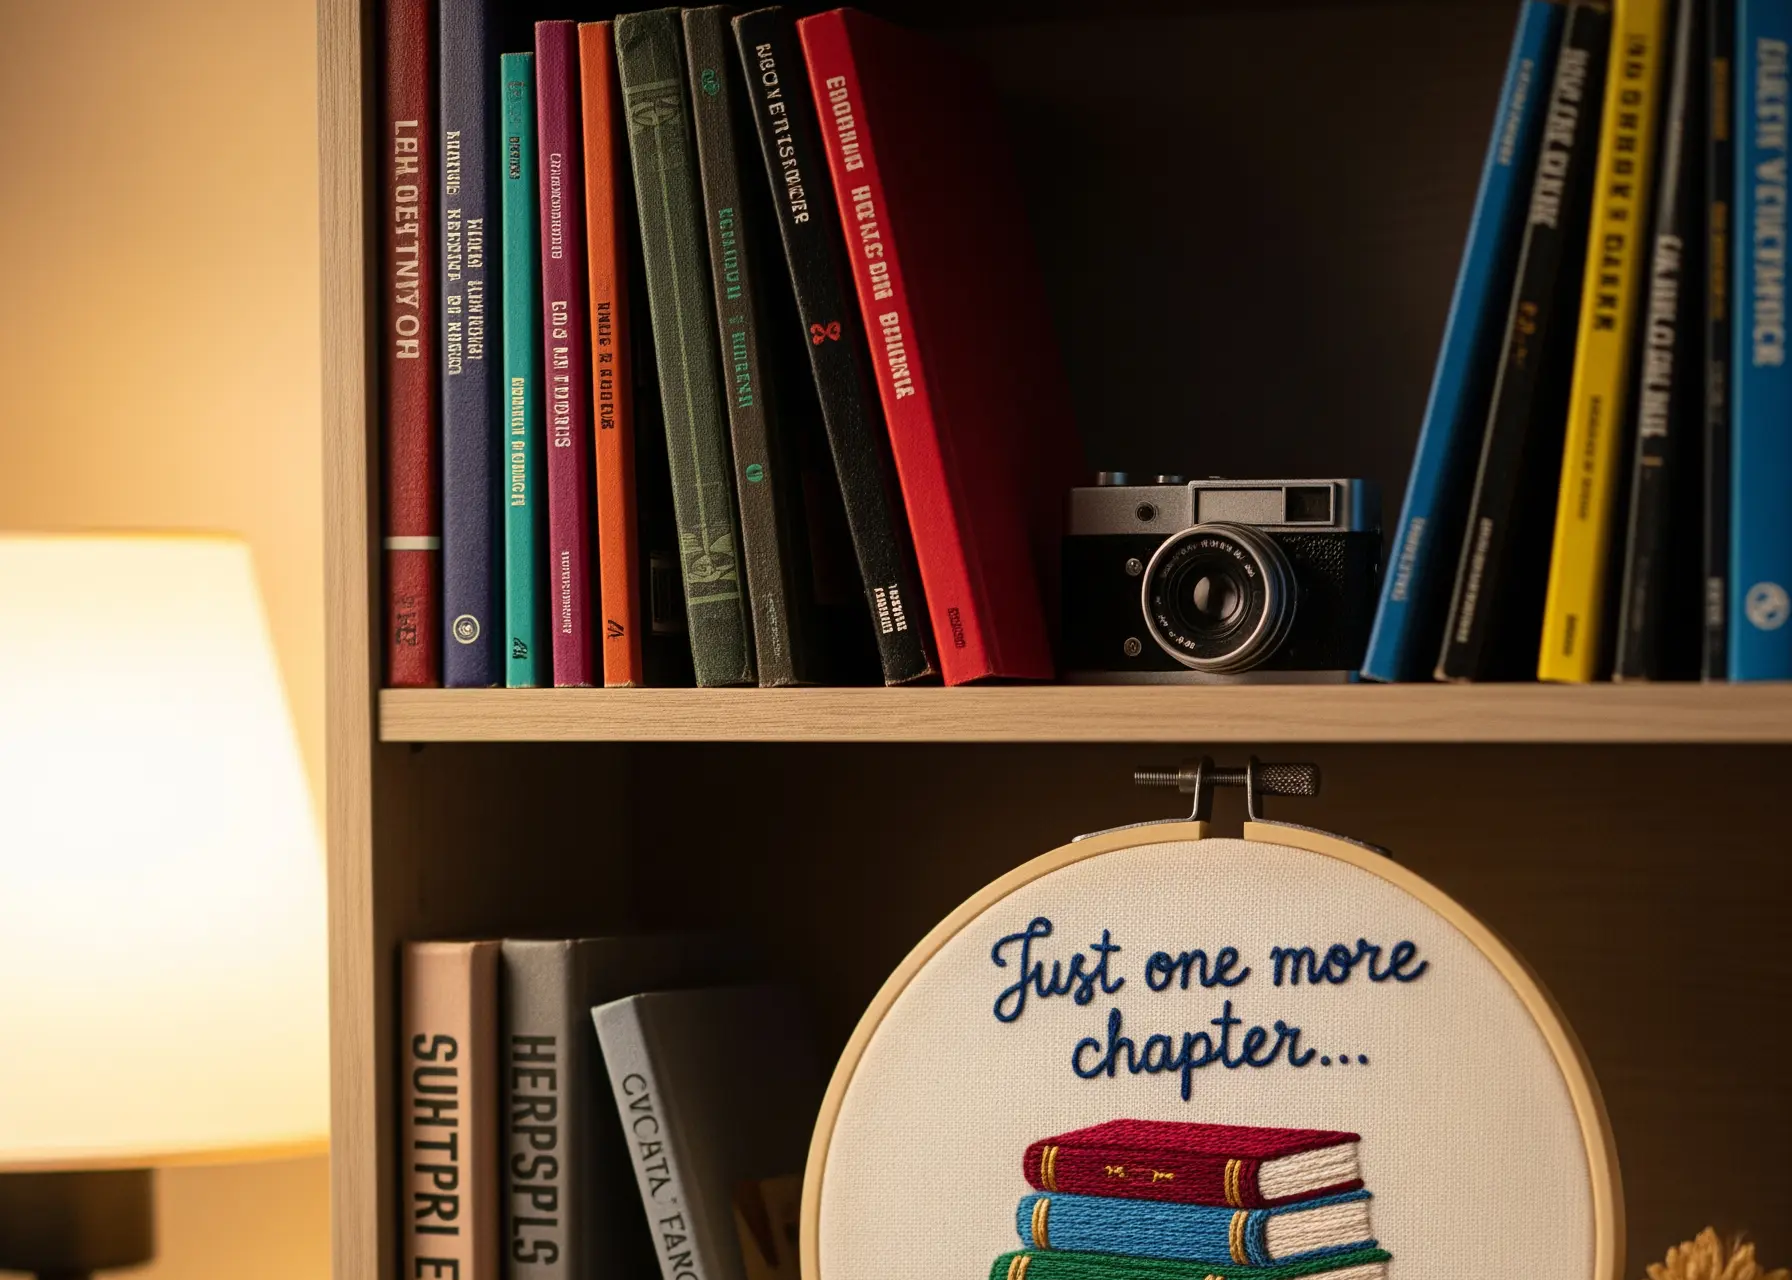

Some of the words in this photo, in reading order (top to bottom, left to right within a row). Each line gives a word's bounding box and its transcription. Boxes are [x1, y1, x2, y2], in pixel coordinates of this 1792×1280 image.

[991, 916, 1125, 1023] Just
[1145, 945, 1250, 992] one
[1270, 938, 1429, 987] more
[1071, 1000, 1369, 1102] chapter...
